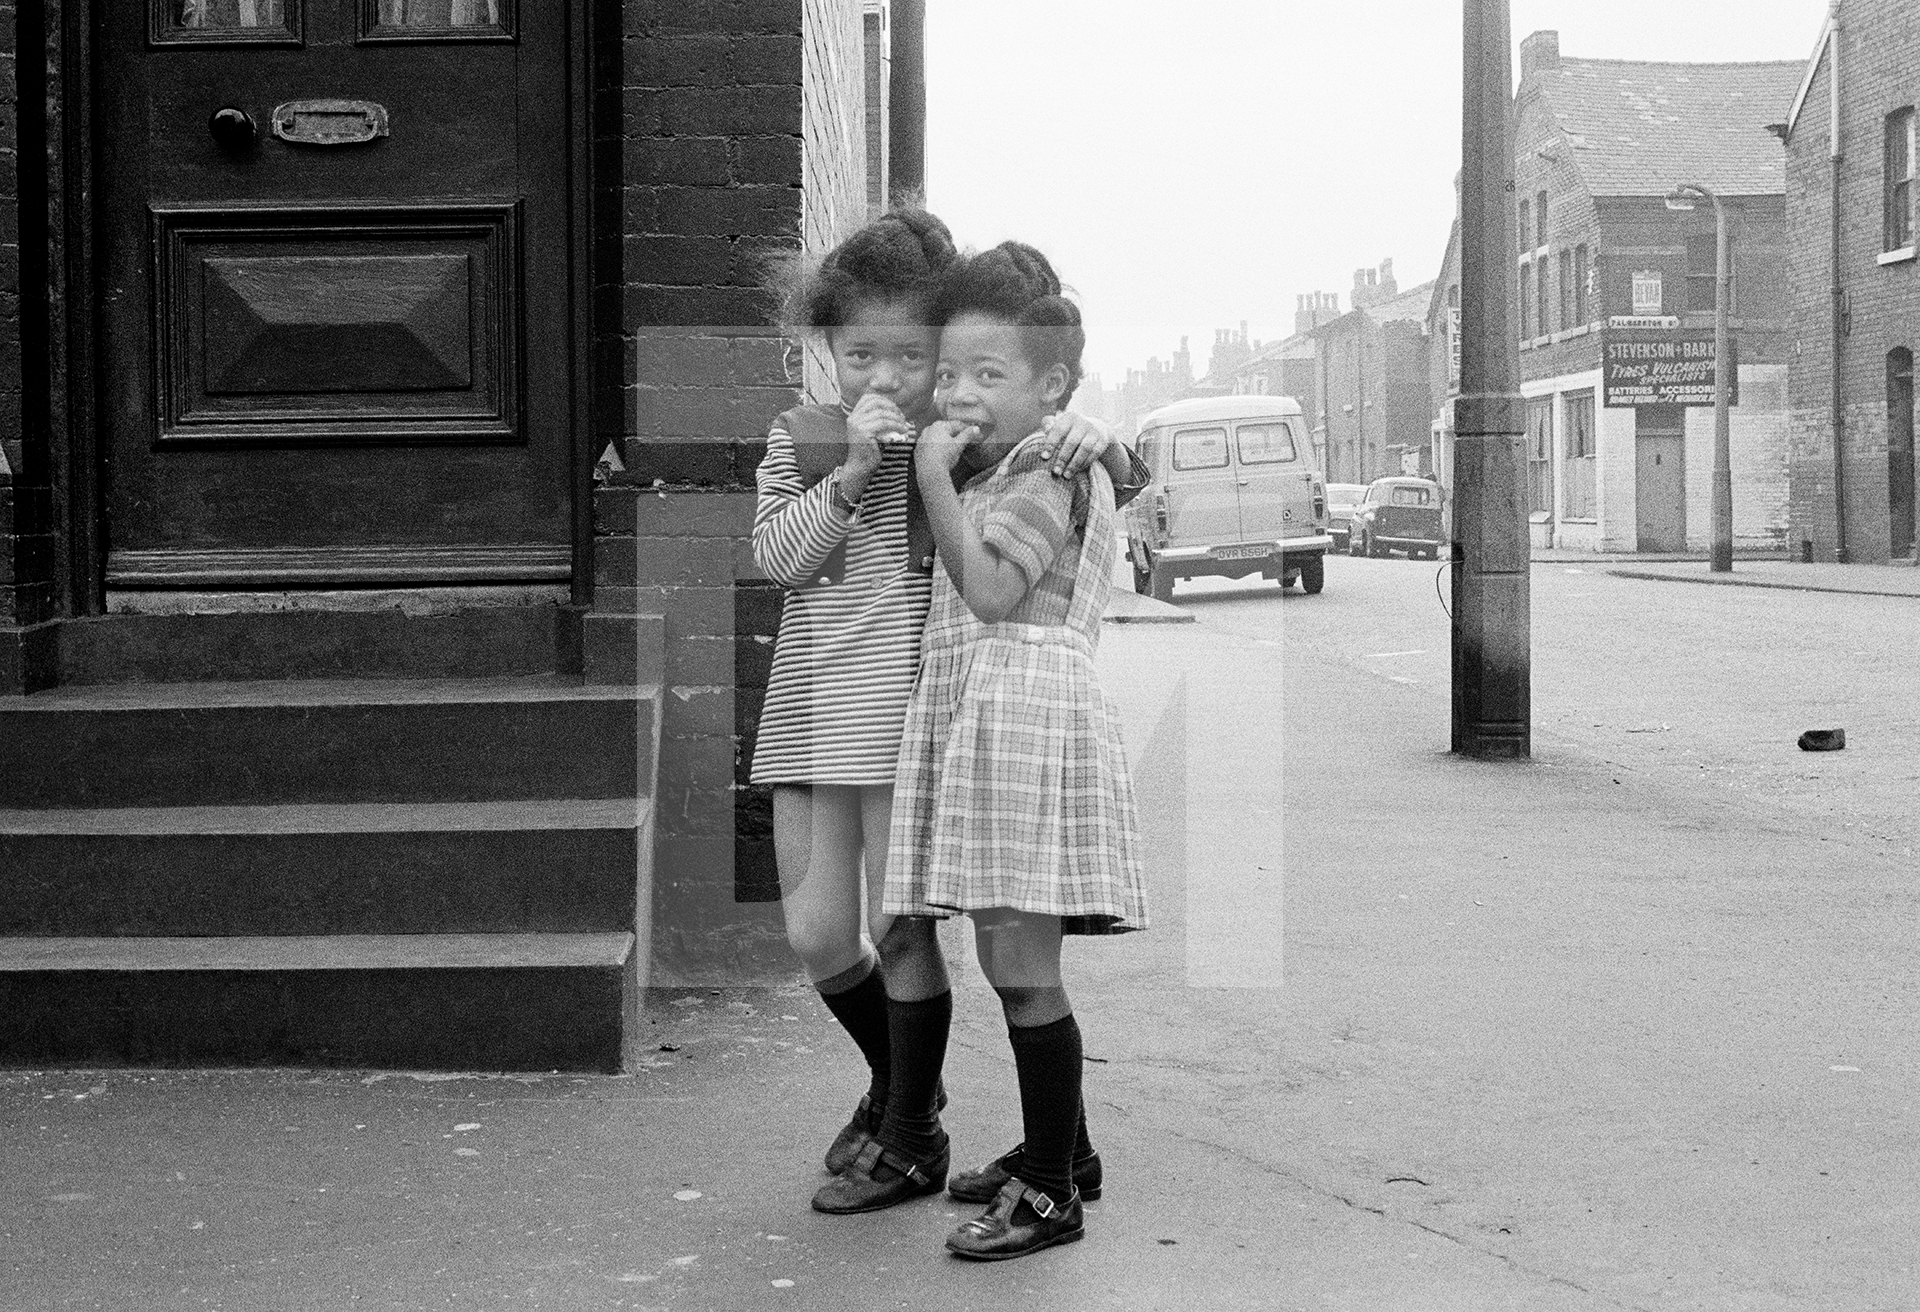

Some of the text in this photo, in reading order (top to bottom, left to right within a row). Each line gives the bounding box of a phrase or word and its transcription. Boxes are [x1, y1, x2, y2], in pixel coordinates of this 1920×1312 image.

[1608, 343, 1675, 359] STEVENSON
[1683, 342, 1716, 358] BARK
[1611, 363, 1649, 379] TYRES
[1639, 370, 1707, 385] SPECIALISTS
[1608, 385, 1716, 396] BATTERIES ACCESSORI
[1218, 548, 1238, 559] OVR
